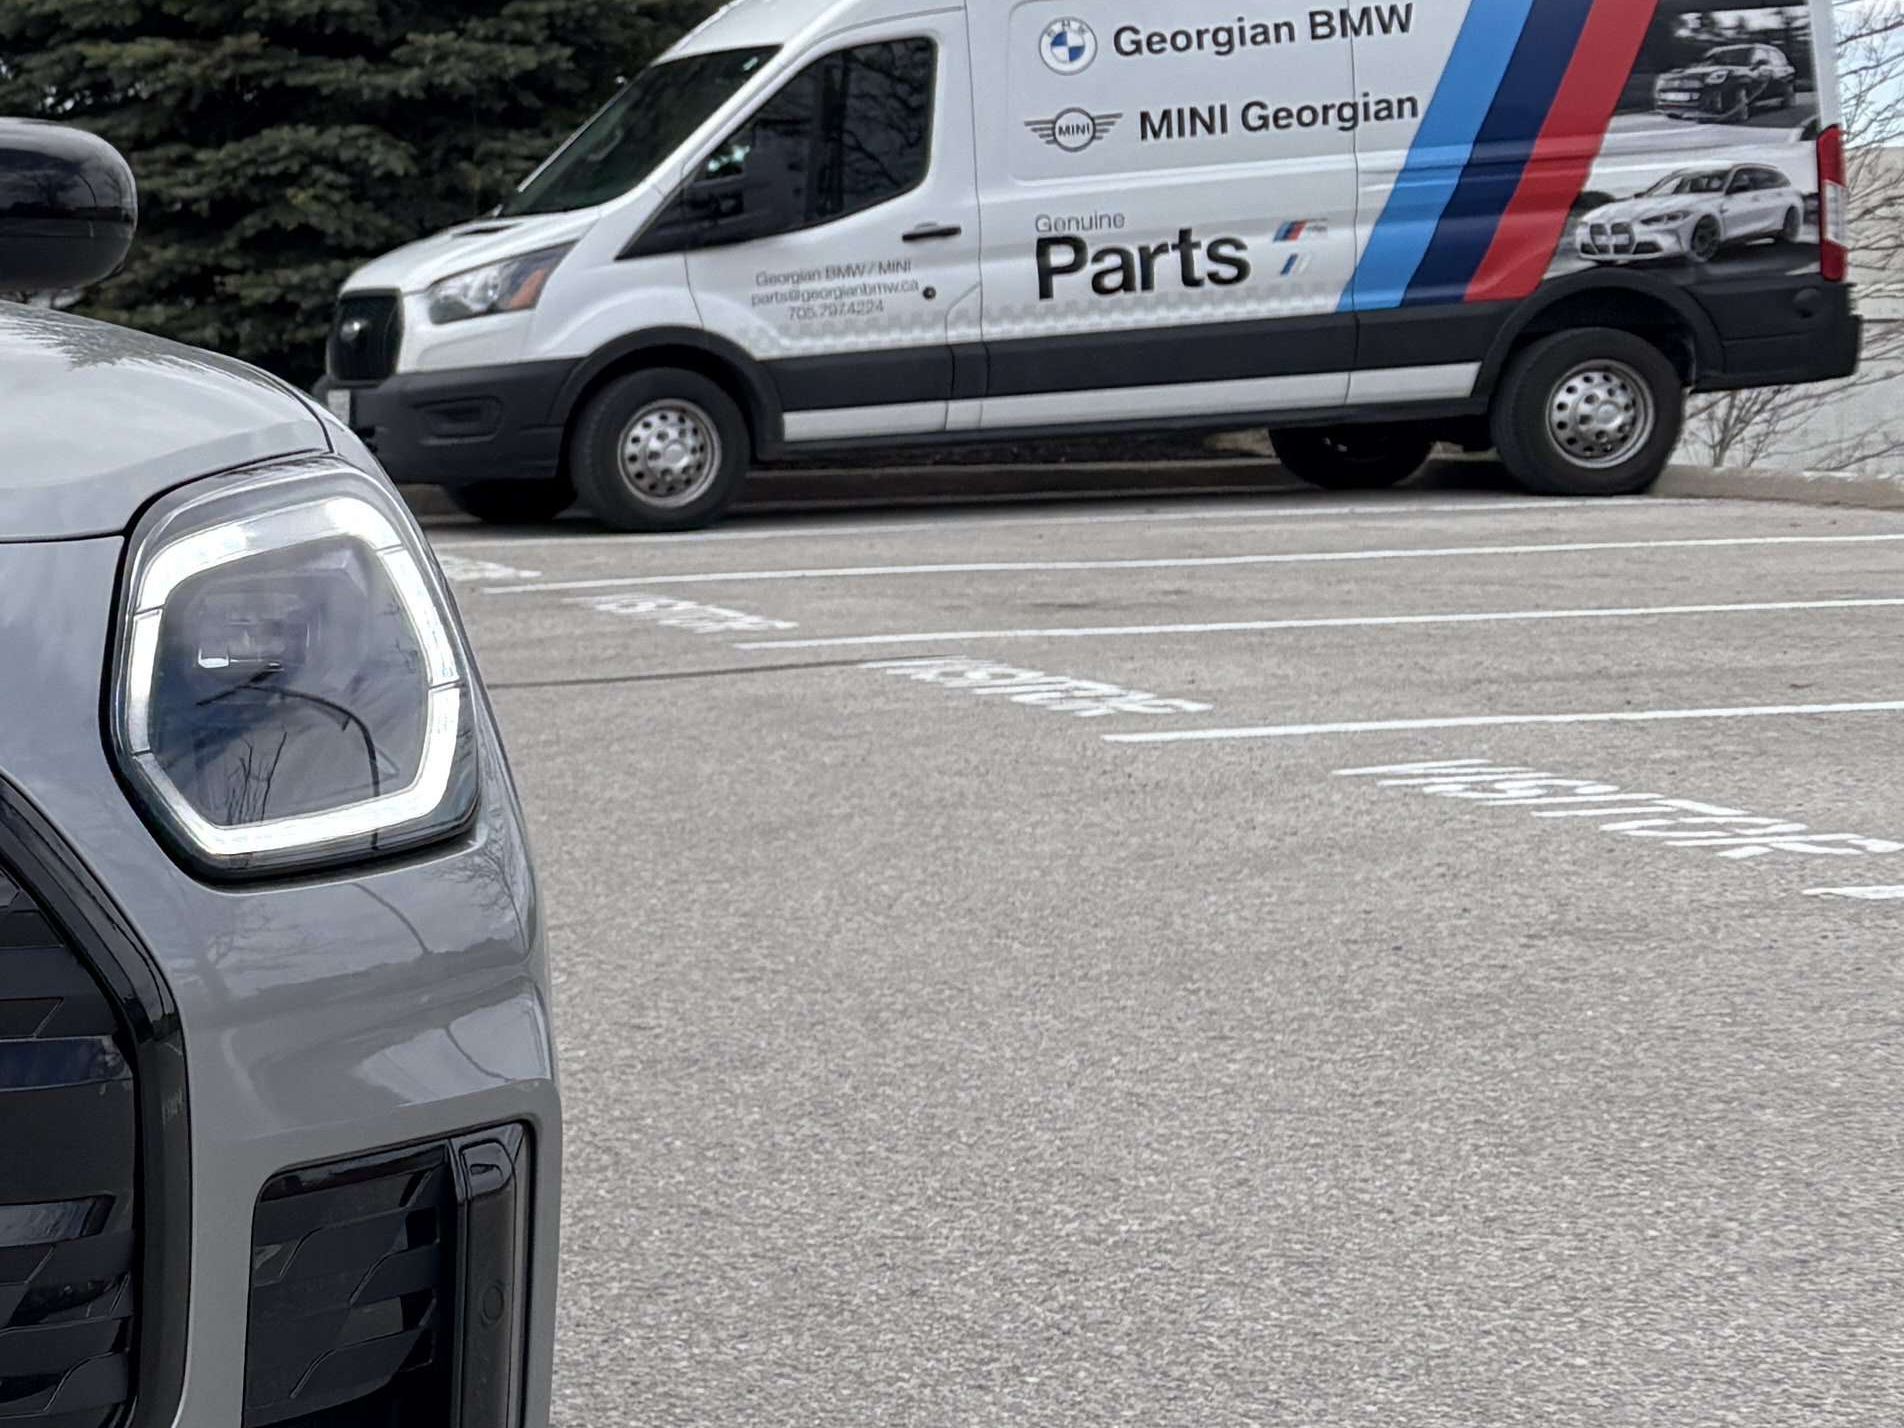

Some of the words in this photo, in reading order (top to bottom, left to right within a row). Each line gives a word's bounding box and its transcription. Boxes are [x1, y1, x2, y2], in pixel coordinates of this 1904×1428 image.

[1113, 17, 1296, 57] Georgian
[1309, 2, 1414, 41] BMW
[1058, 122, 1091, 138] MINI
[1140, 104, 1229, 140] MINI
[1241, 92, 1419, 132] Georgian
[1035, 211, 1126, 233] Genuine
[755, 269, 822, 288] Georgian
[825, 264, 865, 280] BMW
[878, 259, 912, 275] MINI
[1035, 228, 1252, 300] Parts
[1332, 758, 1904, 859] VISITOR
